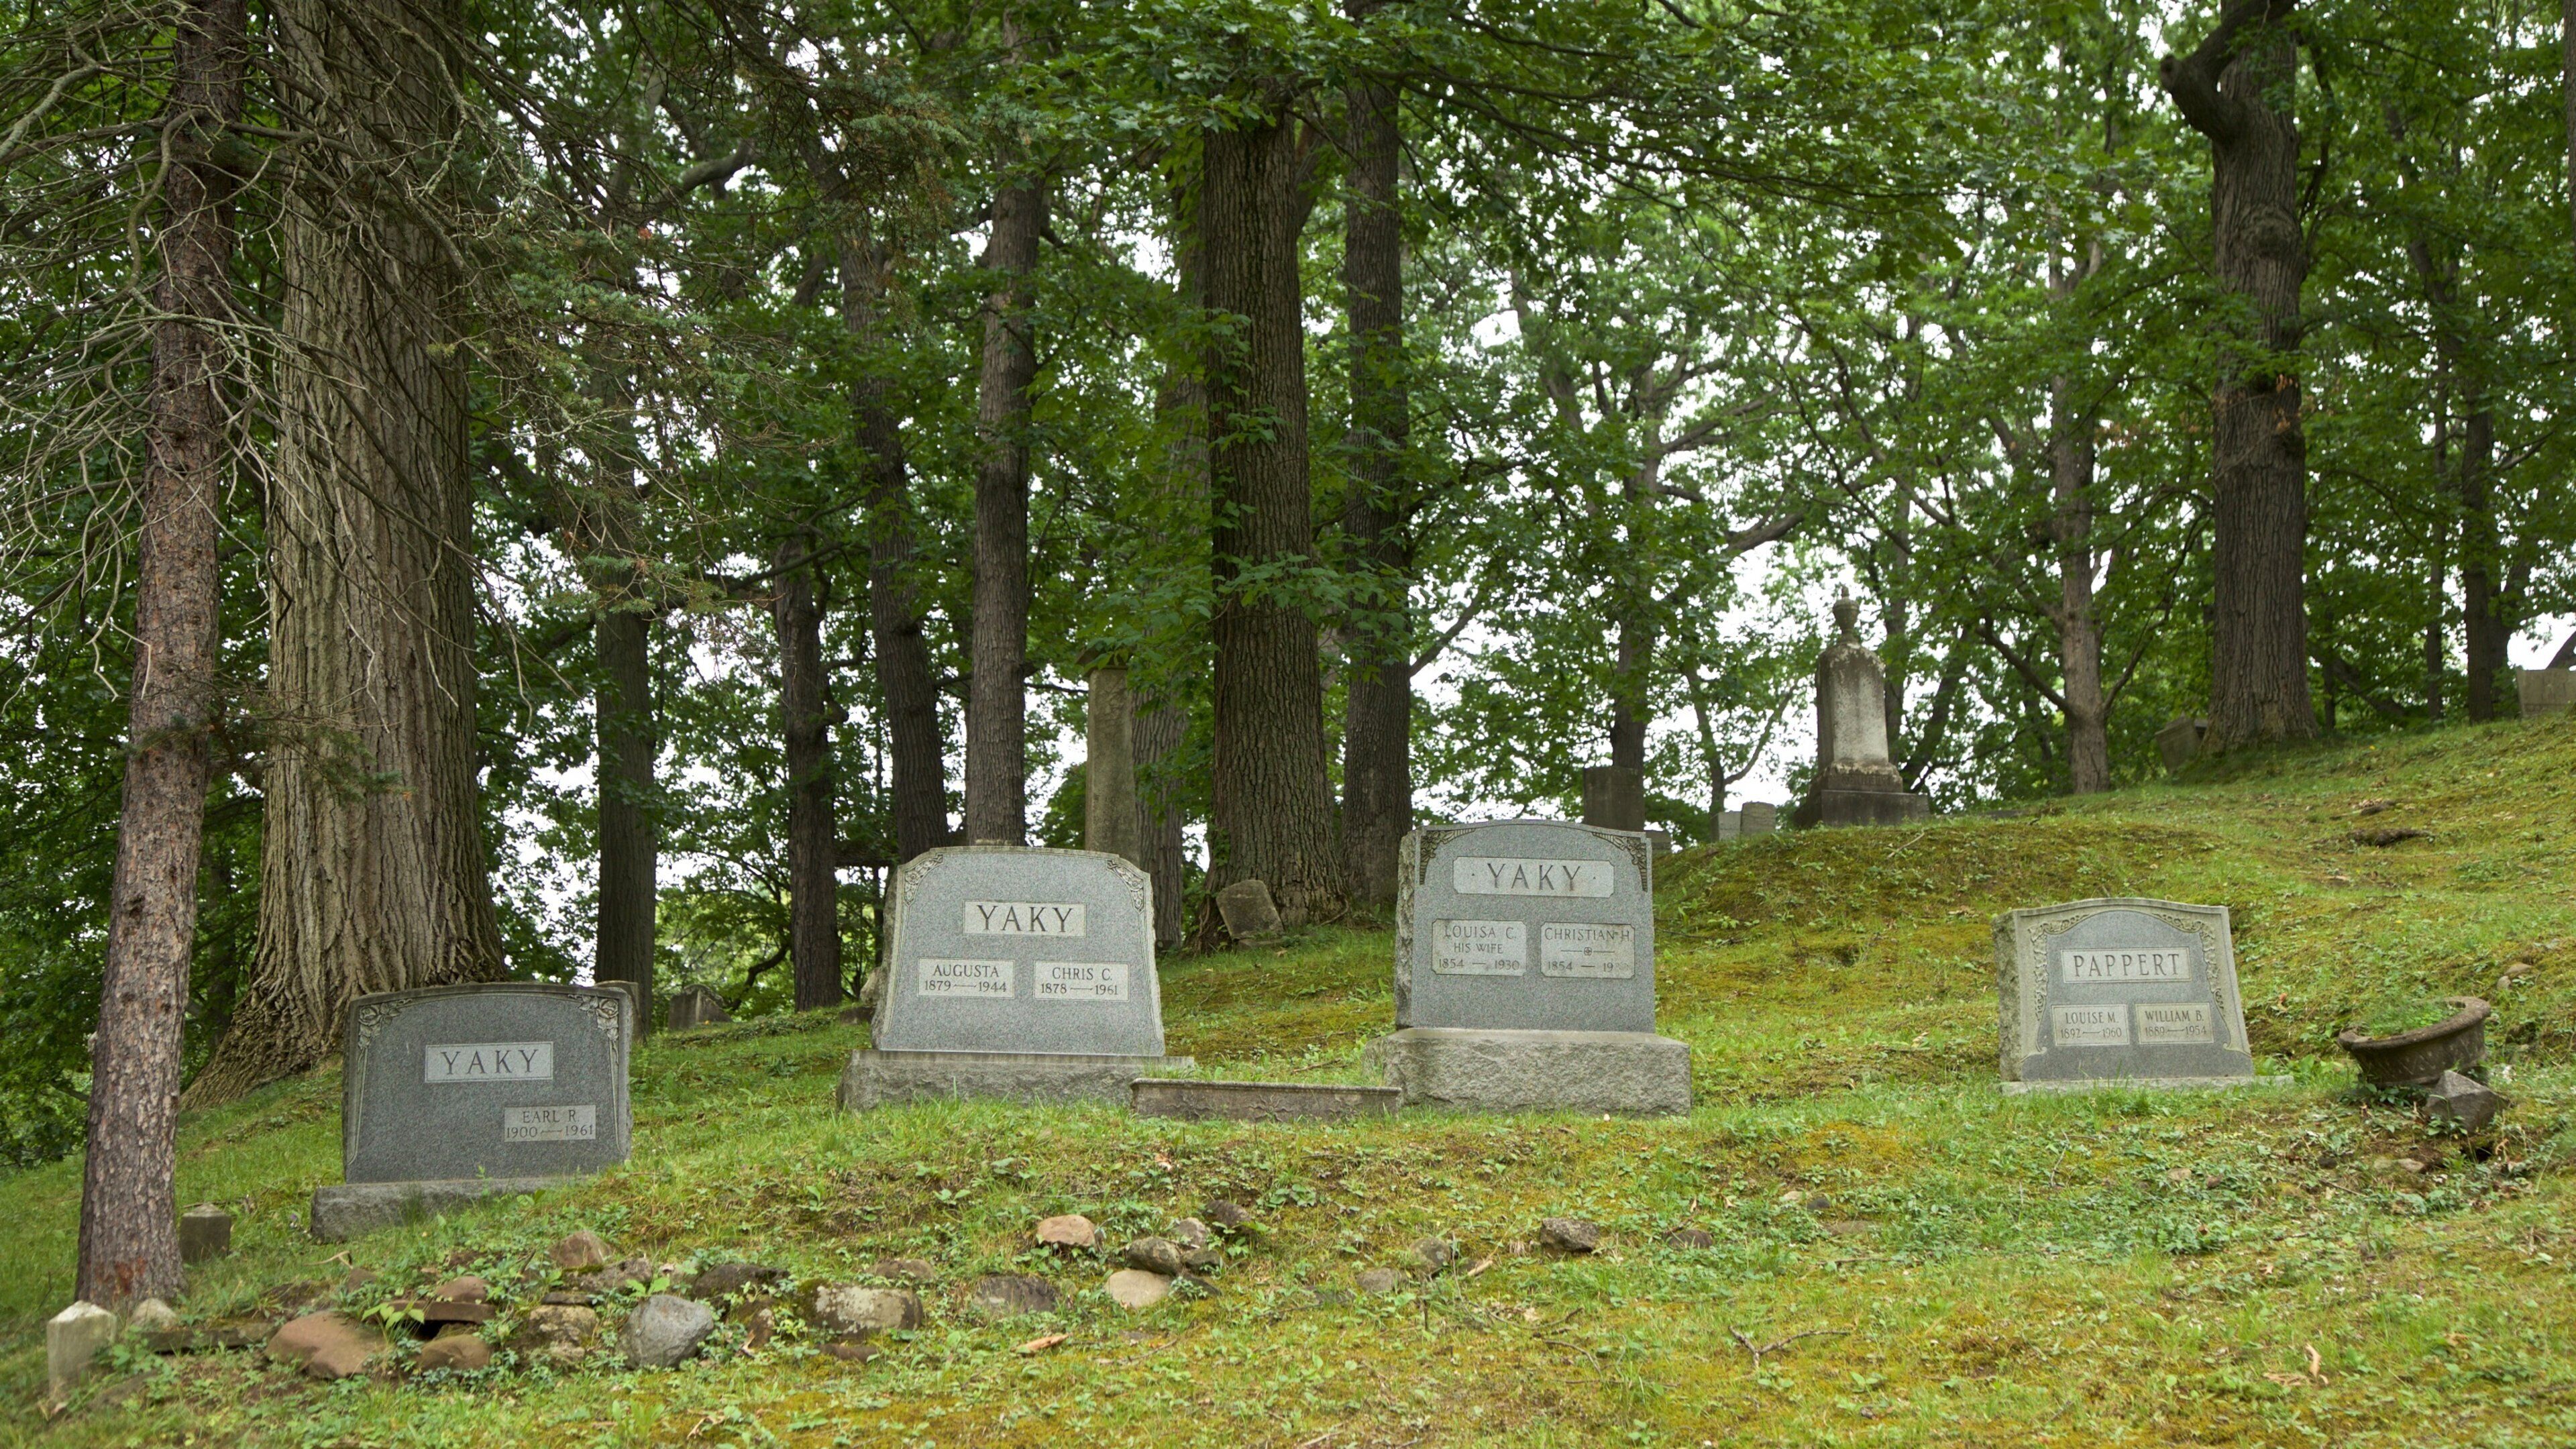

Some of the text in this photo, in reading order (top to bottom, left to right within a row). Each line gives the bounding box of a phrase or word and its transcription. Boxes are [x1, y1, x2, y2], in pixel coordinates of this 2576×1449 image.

[1487, 863, 1580, 891] YAKY
[977, 904, 1074, 932] YAKY
[1444, 925, 1517, 939] LOUISA C.
[1544, 928, 1615, 941] CHRISTIAN
[1454, 943, 1503, 954] HIS WIFE
[933, 964, 999, 978] AUGUSTA
[1439, 958, 1464, 969] 1854
[1495, 960, 1519, 971] 1930
[1548, 961, 1572, 971] 1854
[2074, 954, 2180, 977] PAPPERT
[1052, 967, 1093, 981] CHRIS
[925, 980, 951, 991] 1879
[978, 981, 1006, 993] 1944
[1041, 983, 1067, 994] 1878
[1095, 985, 1118, 996] 1961
[2065, 1012, 2104, 1024] LOUISE
[2145, 1010, 2190, 1022] WILLIAM
[2186, 1026, 2206, 1036] 1954
[440, 1049, 538, 1075] YAKY
[523, 1110, 560, 1123] EARL
[506, 1126, 537, 1138] 1900
[565, 1125, 593, 1136] 1961
